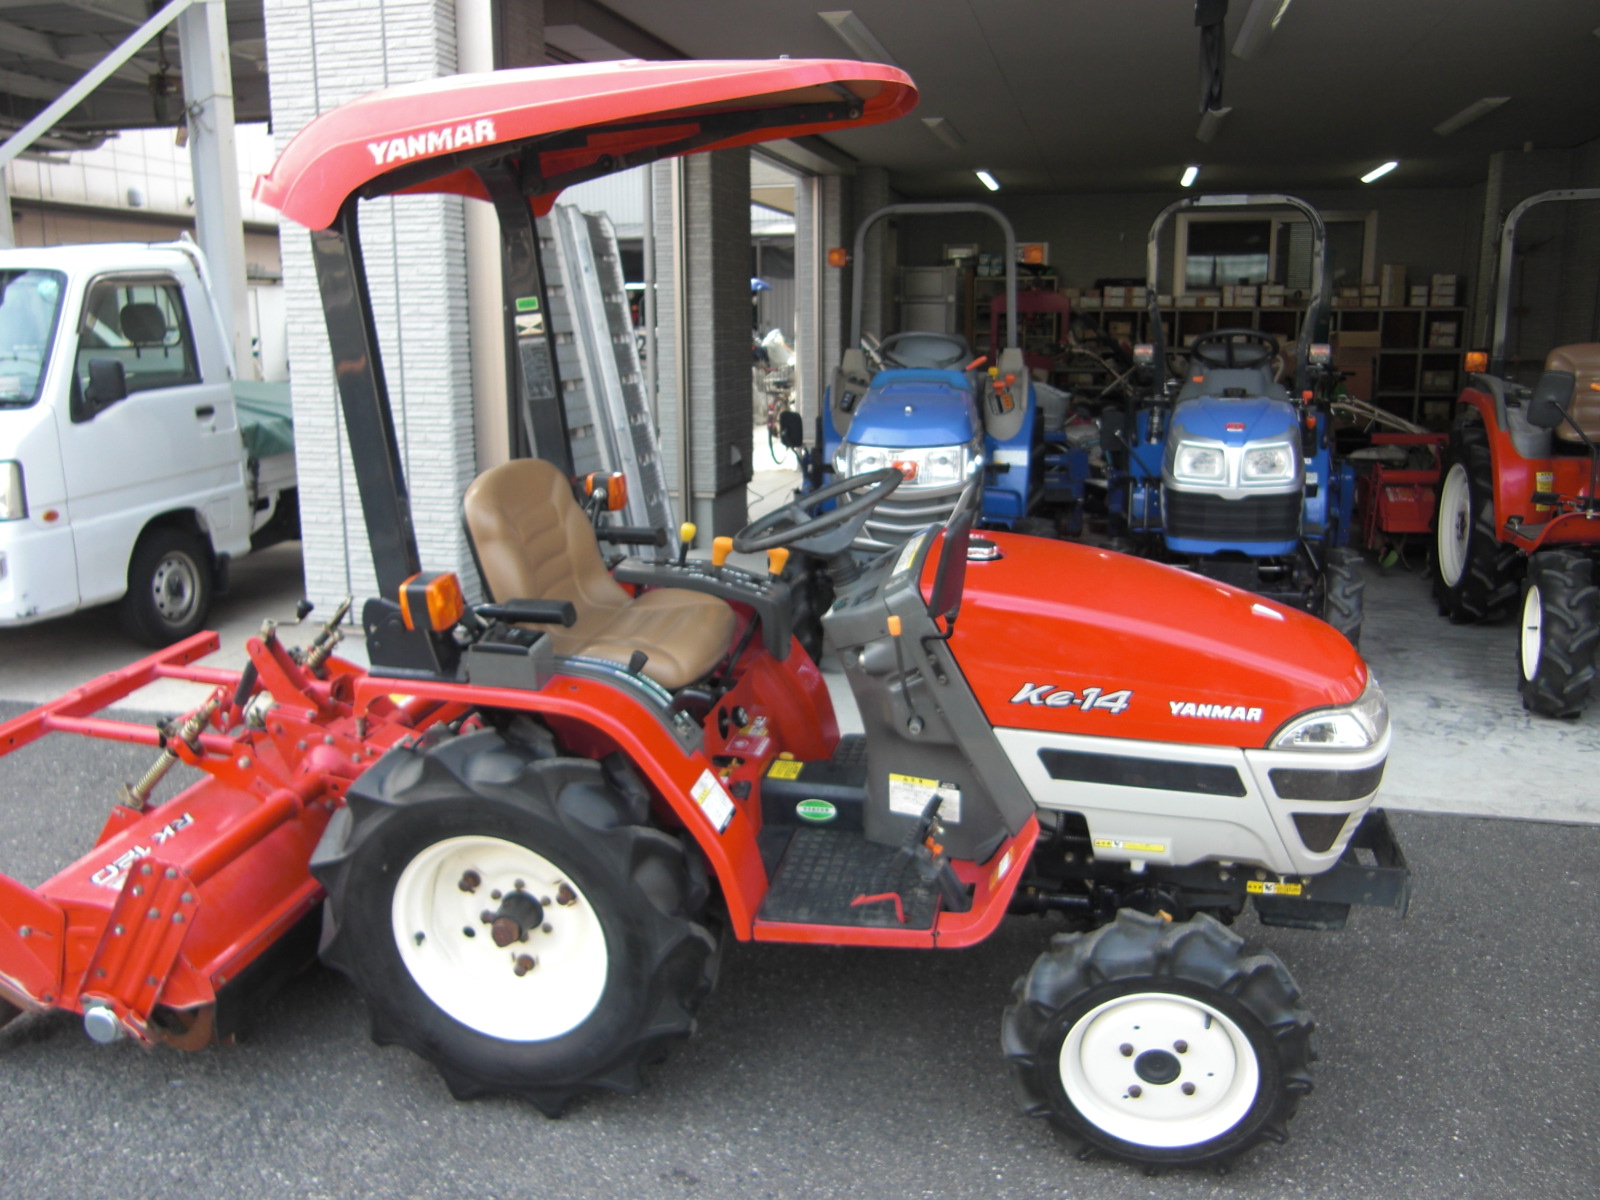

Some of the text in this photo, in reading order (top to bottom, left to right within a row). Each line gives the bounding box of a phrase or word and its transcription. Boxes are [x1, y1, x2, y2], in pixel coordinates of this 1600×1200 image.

[367, 118, 497, 165] YANMAR
[1010, 682, 1133, 715] Ke-14
[1169, 701, 1263, 723] YANMAR
[151, 812, 195, 845] RK
